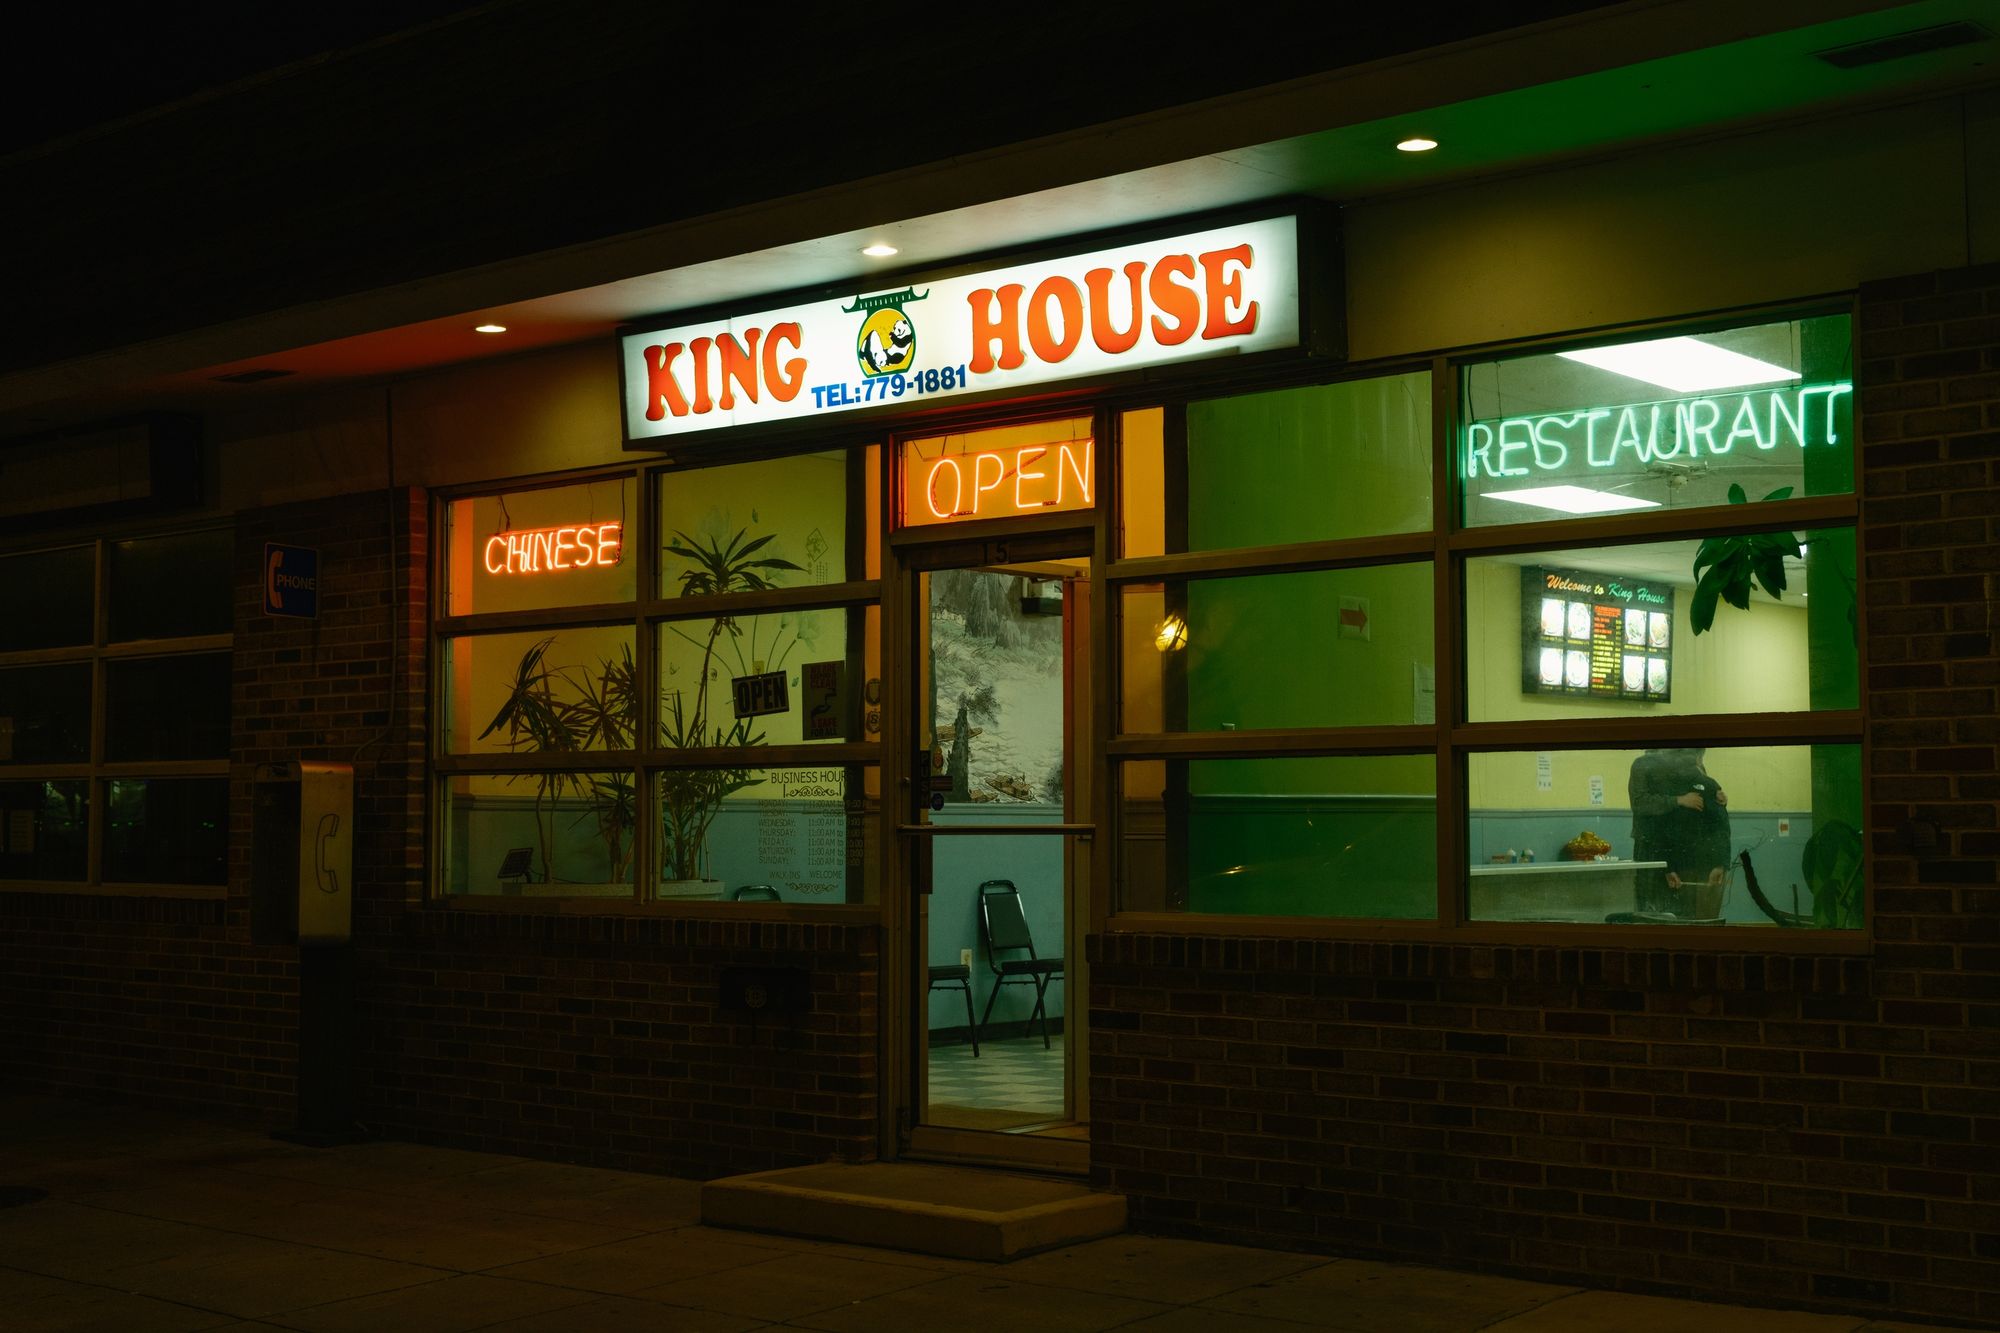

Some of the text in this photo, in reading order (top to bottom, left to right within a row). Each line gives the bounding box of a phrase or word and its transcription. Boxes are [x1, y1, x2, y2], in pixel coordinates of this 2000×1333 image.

[646, 243, 1259, 421] KING HOUSE
[811, 364, 967, 410] TEL:779-1881
[1466, 384, 1853, 479] RESTAURANT
[925, 440, 1095, 519] OPEN
[484, 521, 622, 576] CHINESE
[983, 543, 1008, 561] 15
[275, 574, 317, 591] PHONE
[1546, 574, 1666, 604] Welcome to King House
[737, 676, 787, 713] OPEN
[771, 770, 853, 784] BUSINESS HOUR
[809, 870, 843, 880] WELCOME
